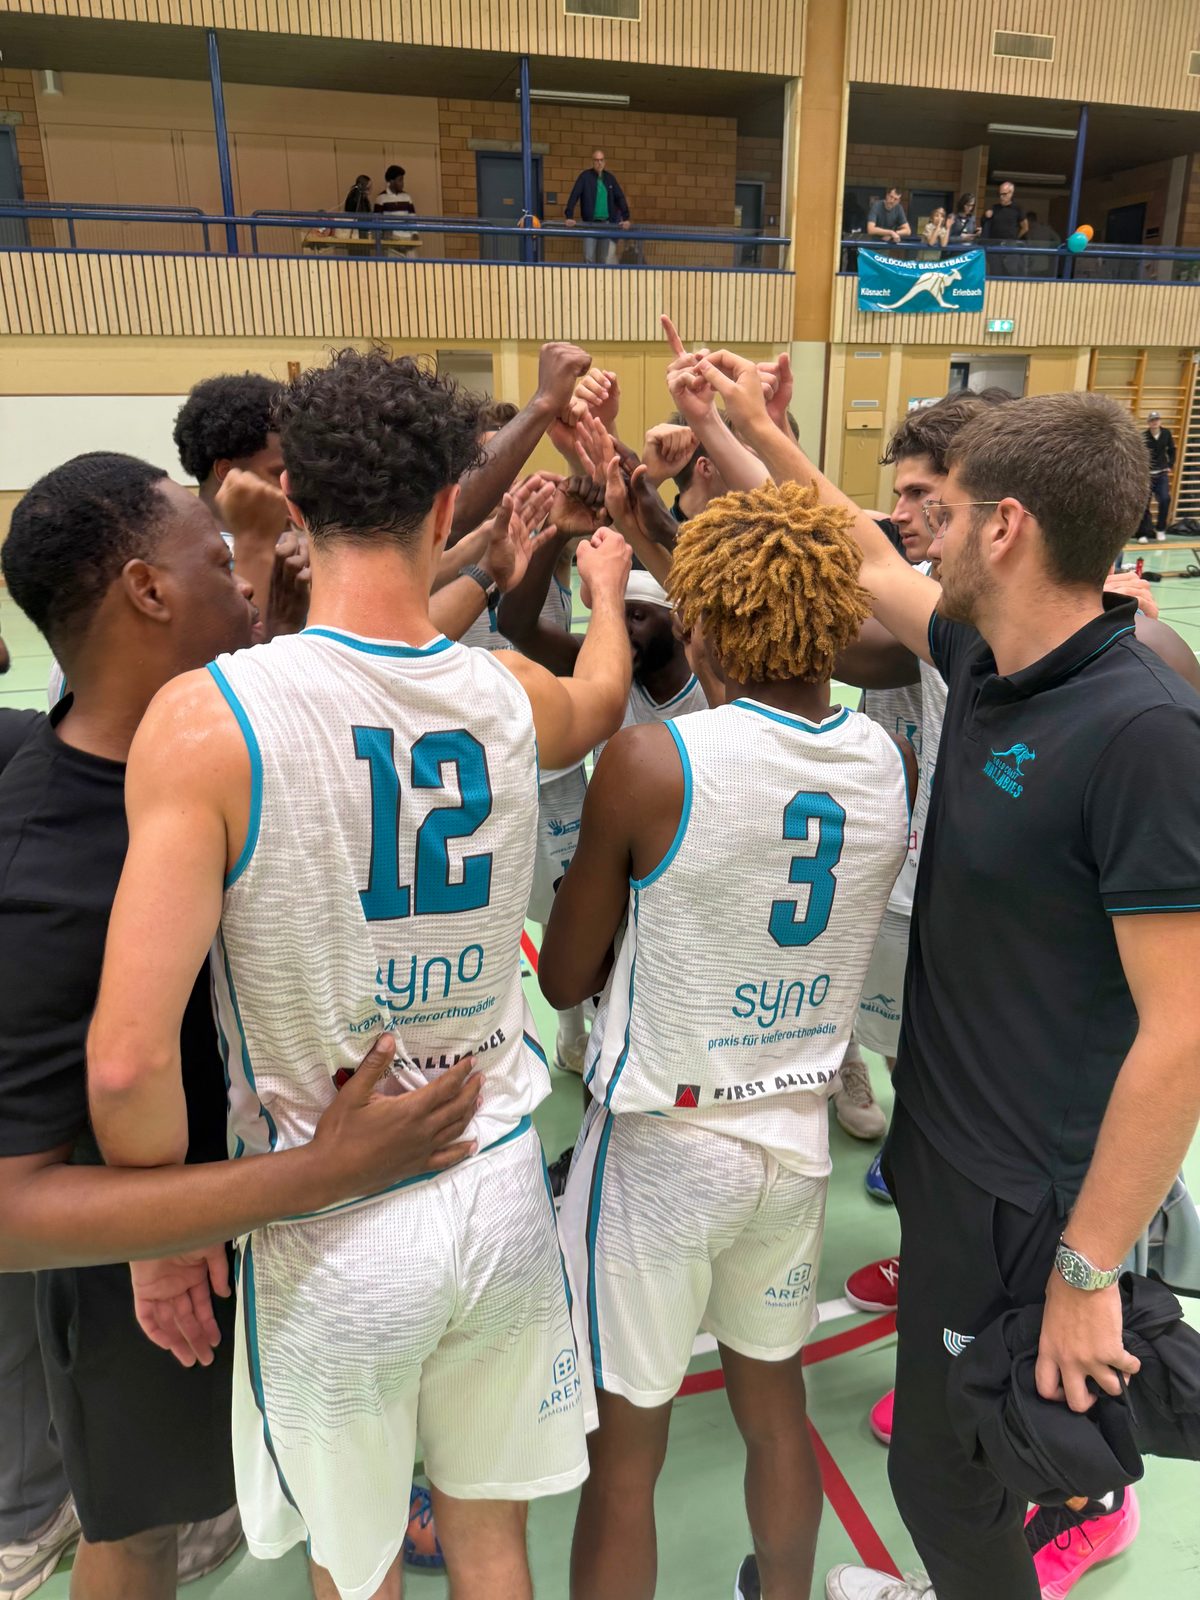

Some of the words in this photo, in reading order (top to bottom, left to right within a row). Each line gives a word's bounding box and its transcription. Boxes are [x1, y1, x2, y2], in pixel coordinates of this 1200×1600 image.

[874, 255, 917, 270] GOLDCOAST
[918, 255, 972, 270] BASKETBALL
[983, 760, 1023, 798] WALLABIES
[351, 725, 493, 922] 12
[767, 790, 847, 948] 3
[392, 996, 496, 1025] kieferorthopädie
[732, 974, 831, 1029] syno
[708, 1034, 739, 1051] praxis
[742, 1034, 758, 1046] für
[760, 1023, 837, 1046] kieferorthopädie
[714, 1081, 766, 1100] FIRST
[765, 1281, 811, 1299] AREN
[539, 1373, 581, 1413] AREN
